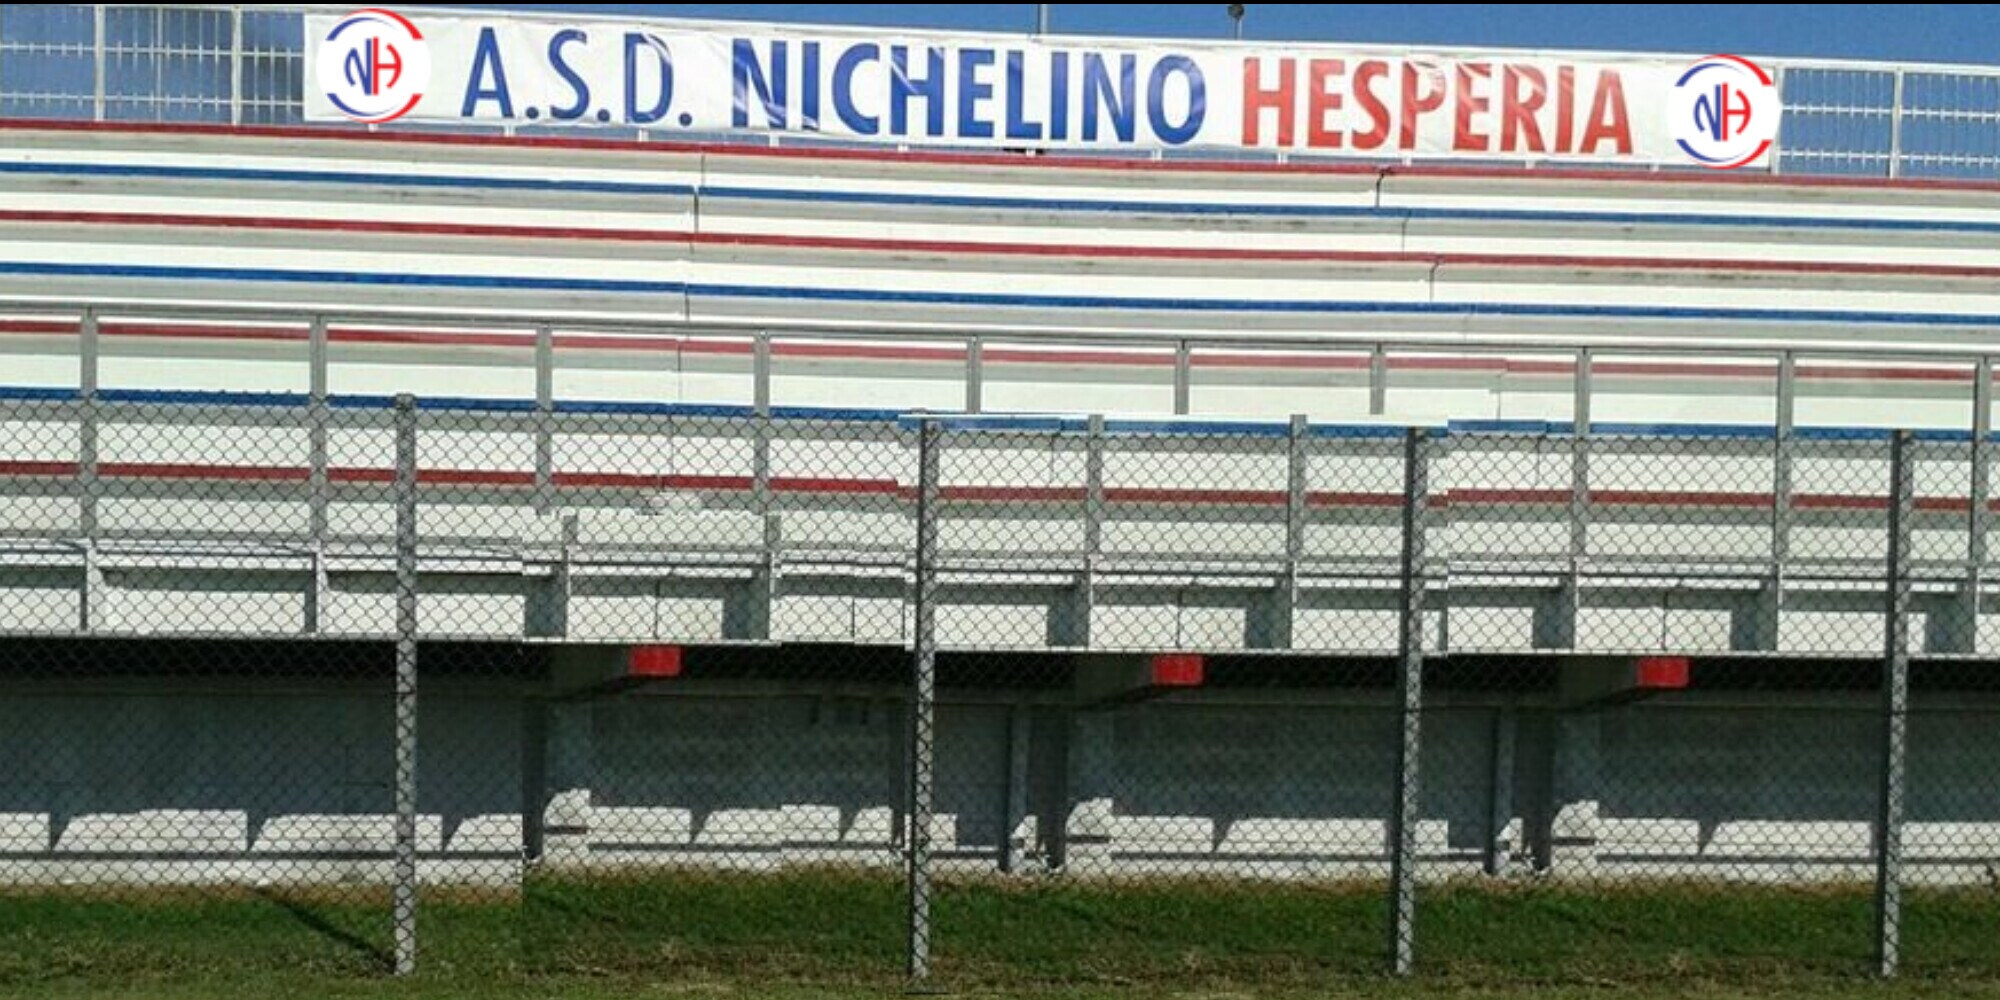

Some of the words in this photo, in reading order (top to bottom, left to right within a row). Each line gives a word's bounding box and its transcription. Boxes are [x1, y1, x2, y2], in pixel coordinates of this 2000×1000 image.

[461, 26, 693, 126] A.S.D.
[732, 38, 1207, 145] NICHELINO
[1241, 57, 1632, 155] HESPERIA
